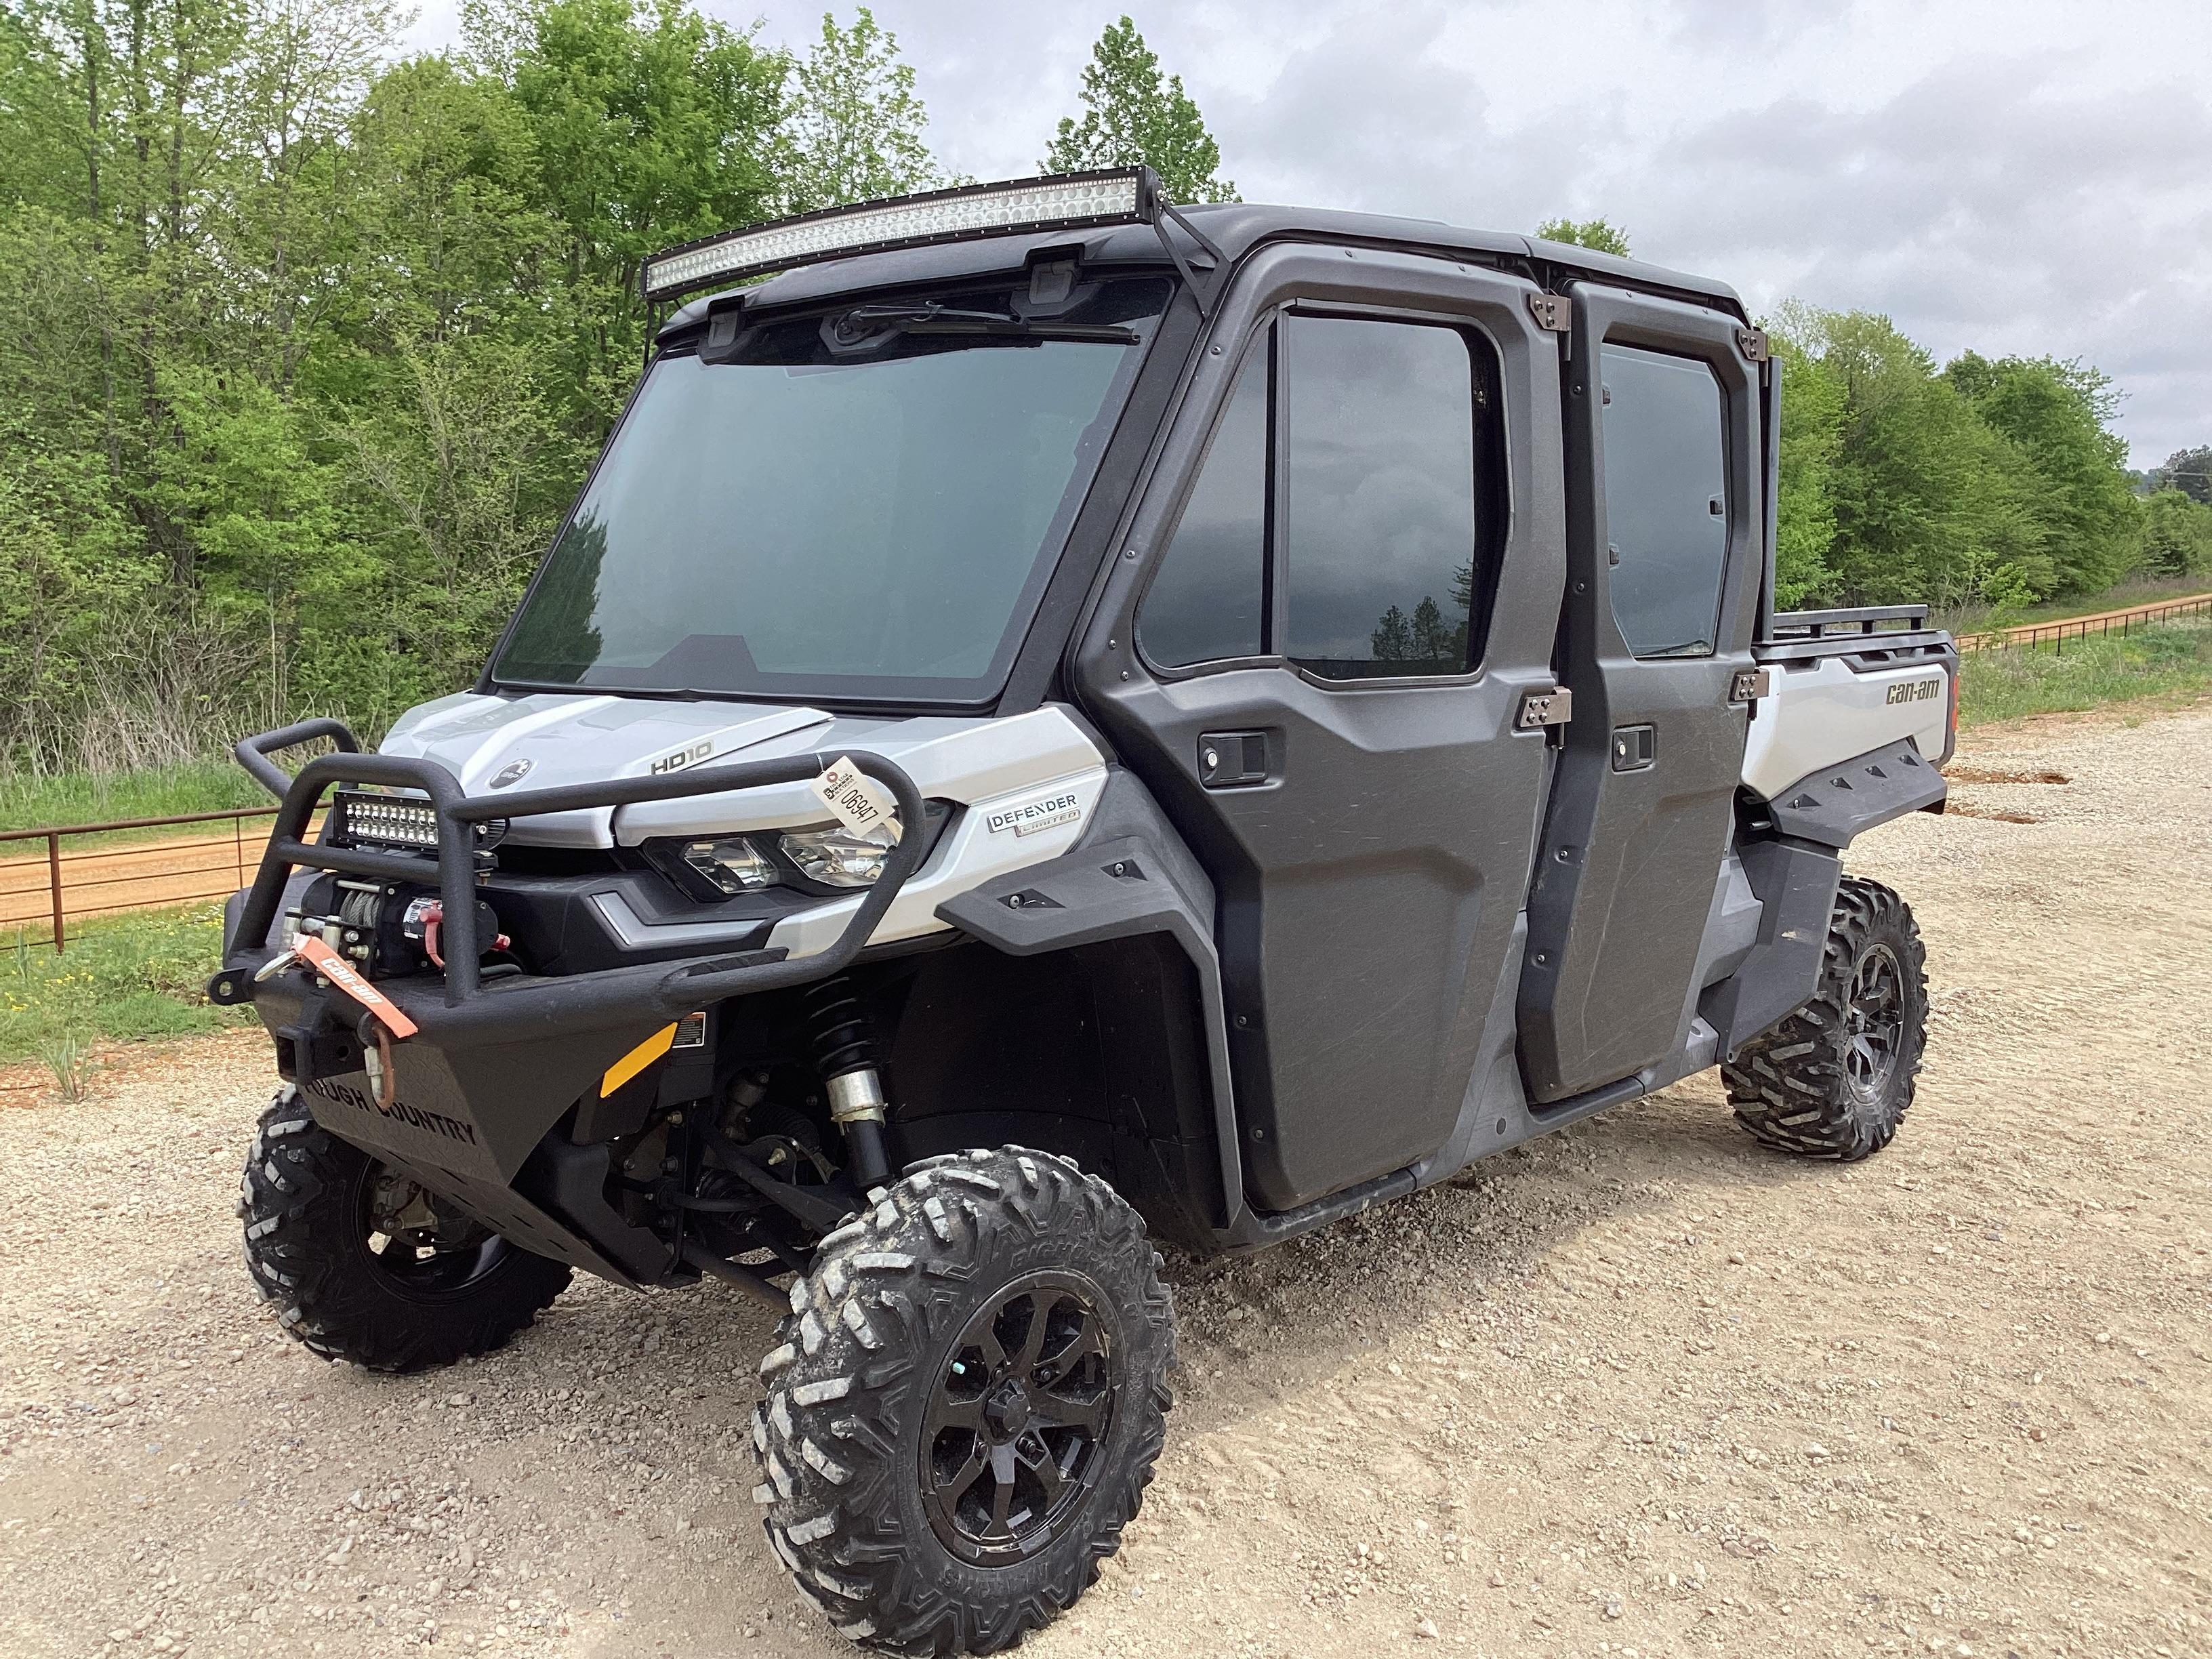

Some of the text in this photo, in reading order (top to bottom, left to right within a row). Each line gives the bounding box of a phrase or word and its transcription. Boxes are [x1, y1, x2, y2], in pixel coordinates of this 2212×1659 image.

[1886, 679, 1940, 705] can-am
[651, 741, 712, 775] HD10
[841, 790, 879, 823] 06947
[991, 794, 1077, 827] DEFENDER
[321, 957, 384, 1004] can-am
